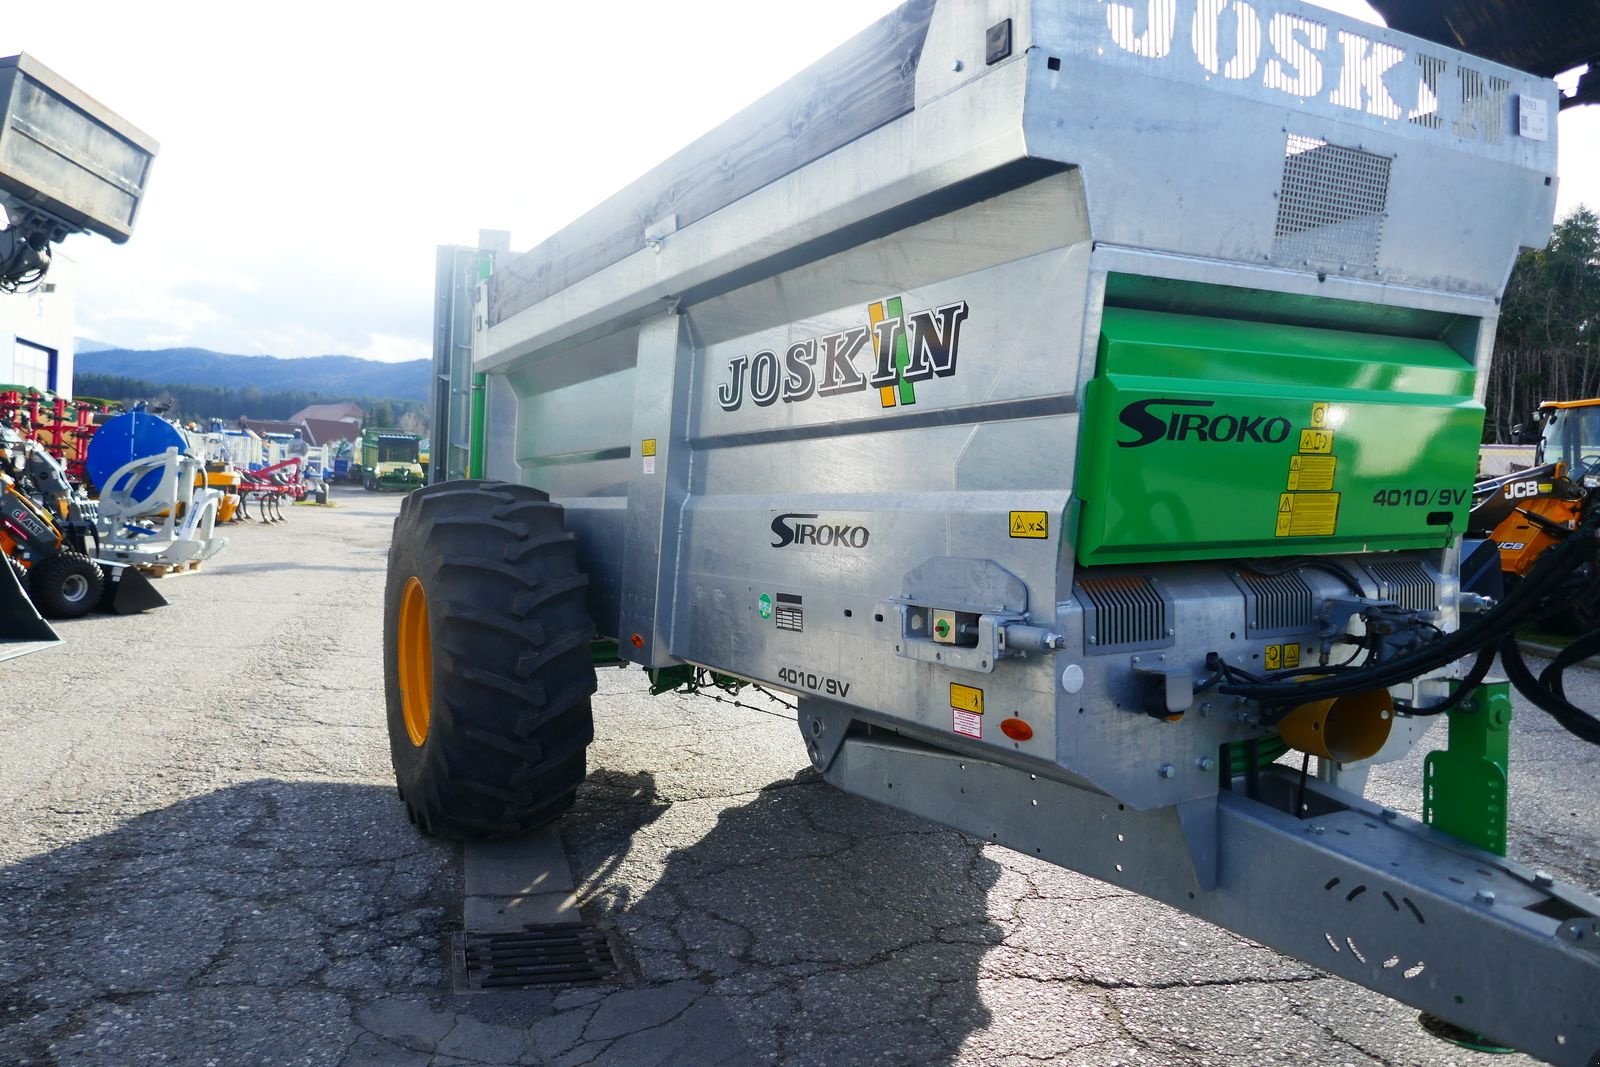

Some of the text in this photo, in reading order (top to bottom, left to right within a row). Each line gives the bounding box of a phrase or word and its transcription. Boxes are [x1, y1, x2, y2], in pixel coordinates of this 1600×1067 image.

[718, 301, 968, 412] JOSKIN
[1116, 397, 1293, 448] SIROKO
[1373, 488, 1468, 506] 4010/9V
[1504, 480, 1538, 500] JCB
[11, 508, 45, 537] GIANT
[771, 513, 870, 549] SIROKO
[1497, 542, 1525, 550] JCB
[778, 667, 850, 698] 4010/9V
